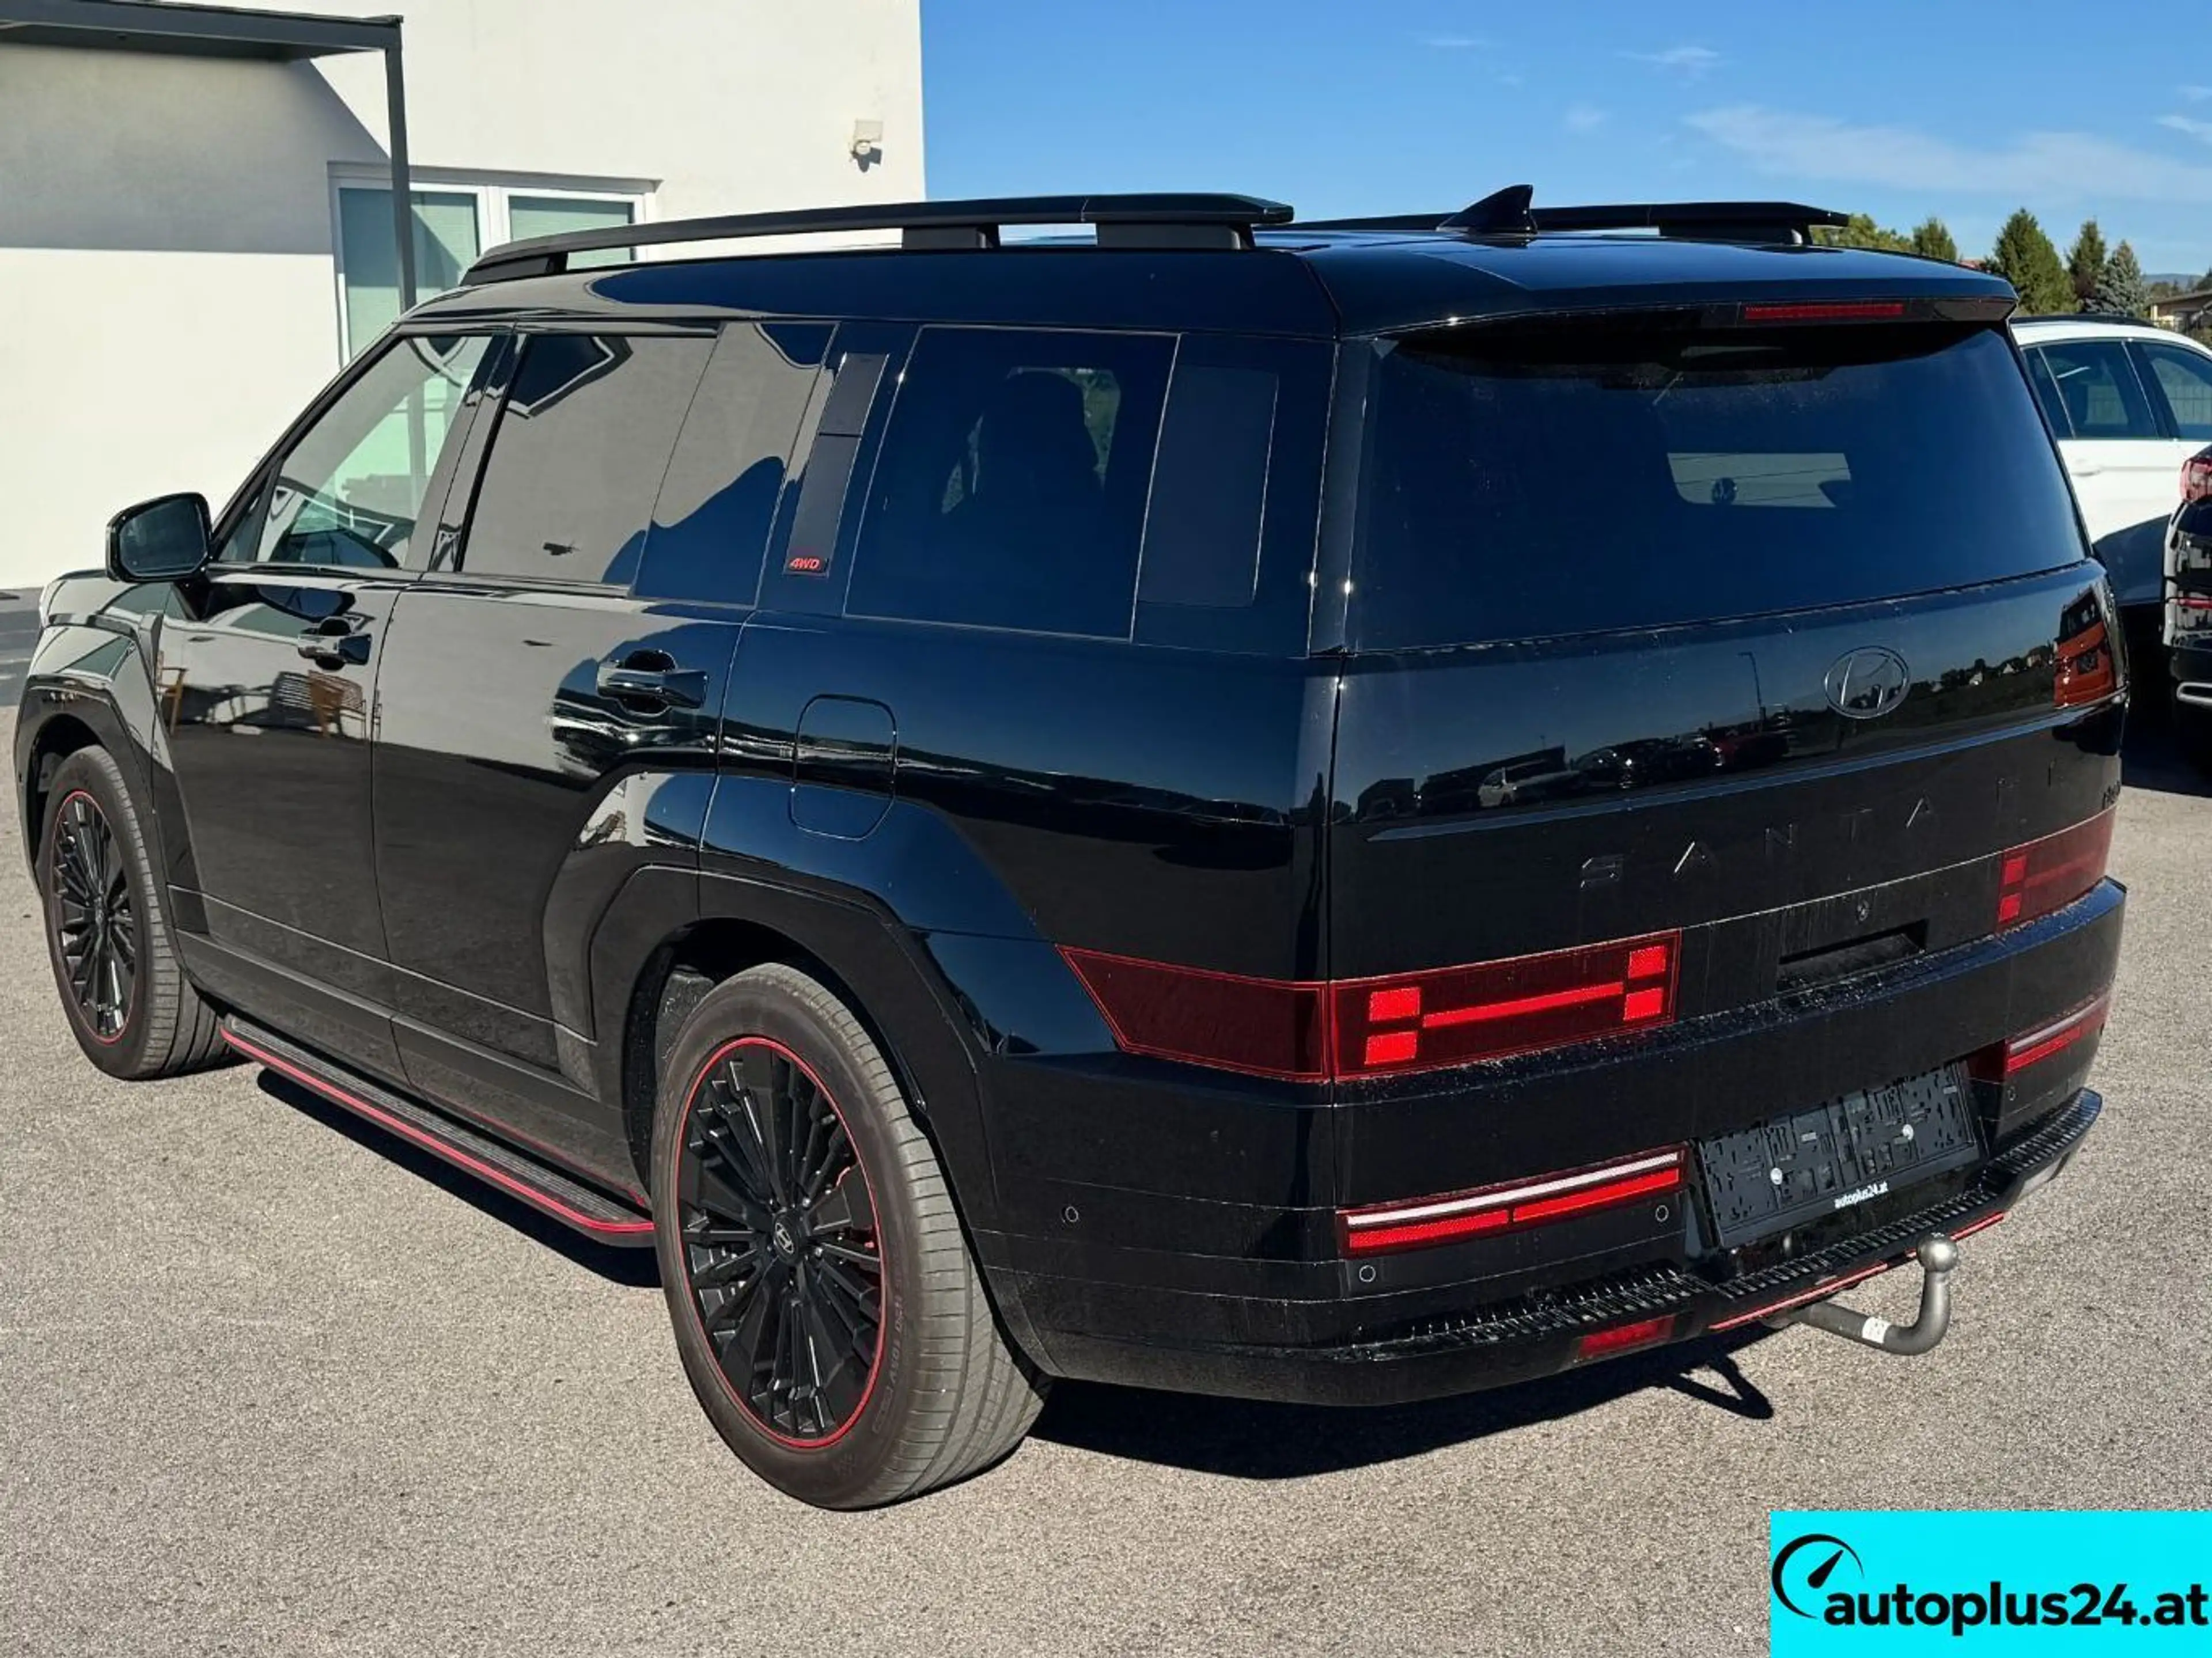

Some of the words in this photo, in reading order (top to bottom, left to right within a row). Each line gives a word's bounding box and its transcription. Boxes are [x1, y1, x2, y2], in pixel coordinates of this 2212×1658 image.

[790, 557, 820, 569] 4WD
[1580, 793, 1937, 890] SANTA
[1834, 1181, 1889, 1209] autoplus24.at
